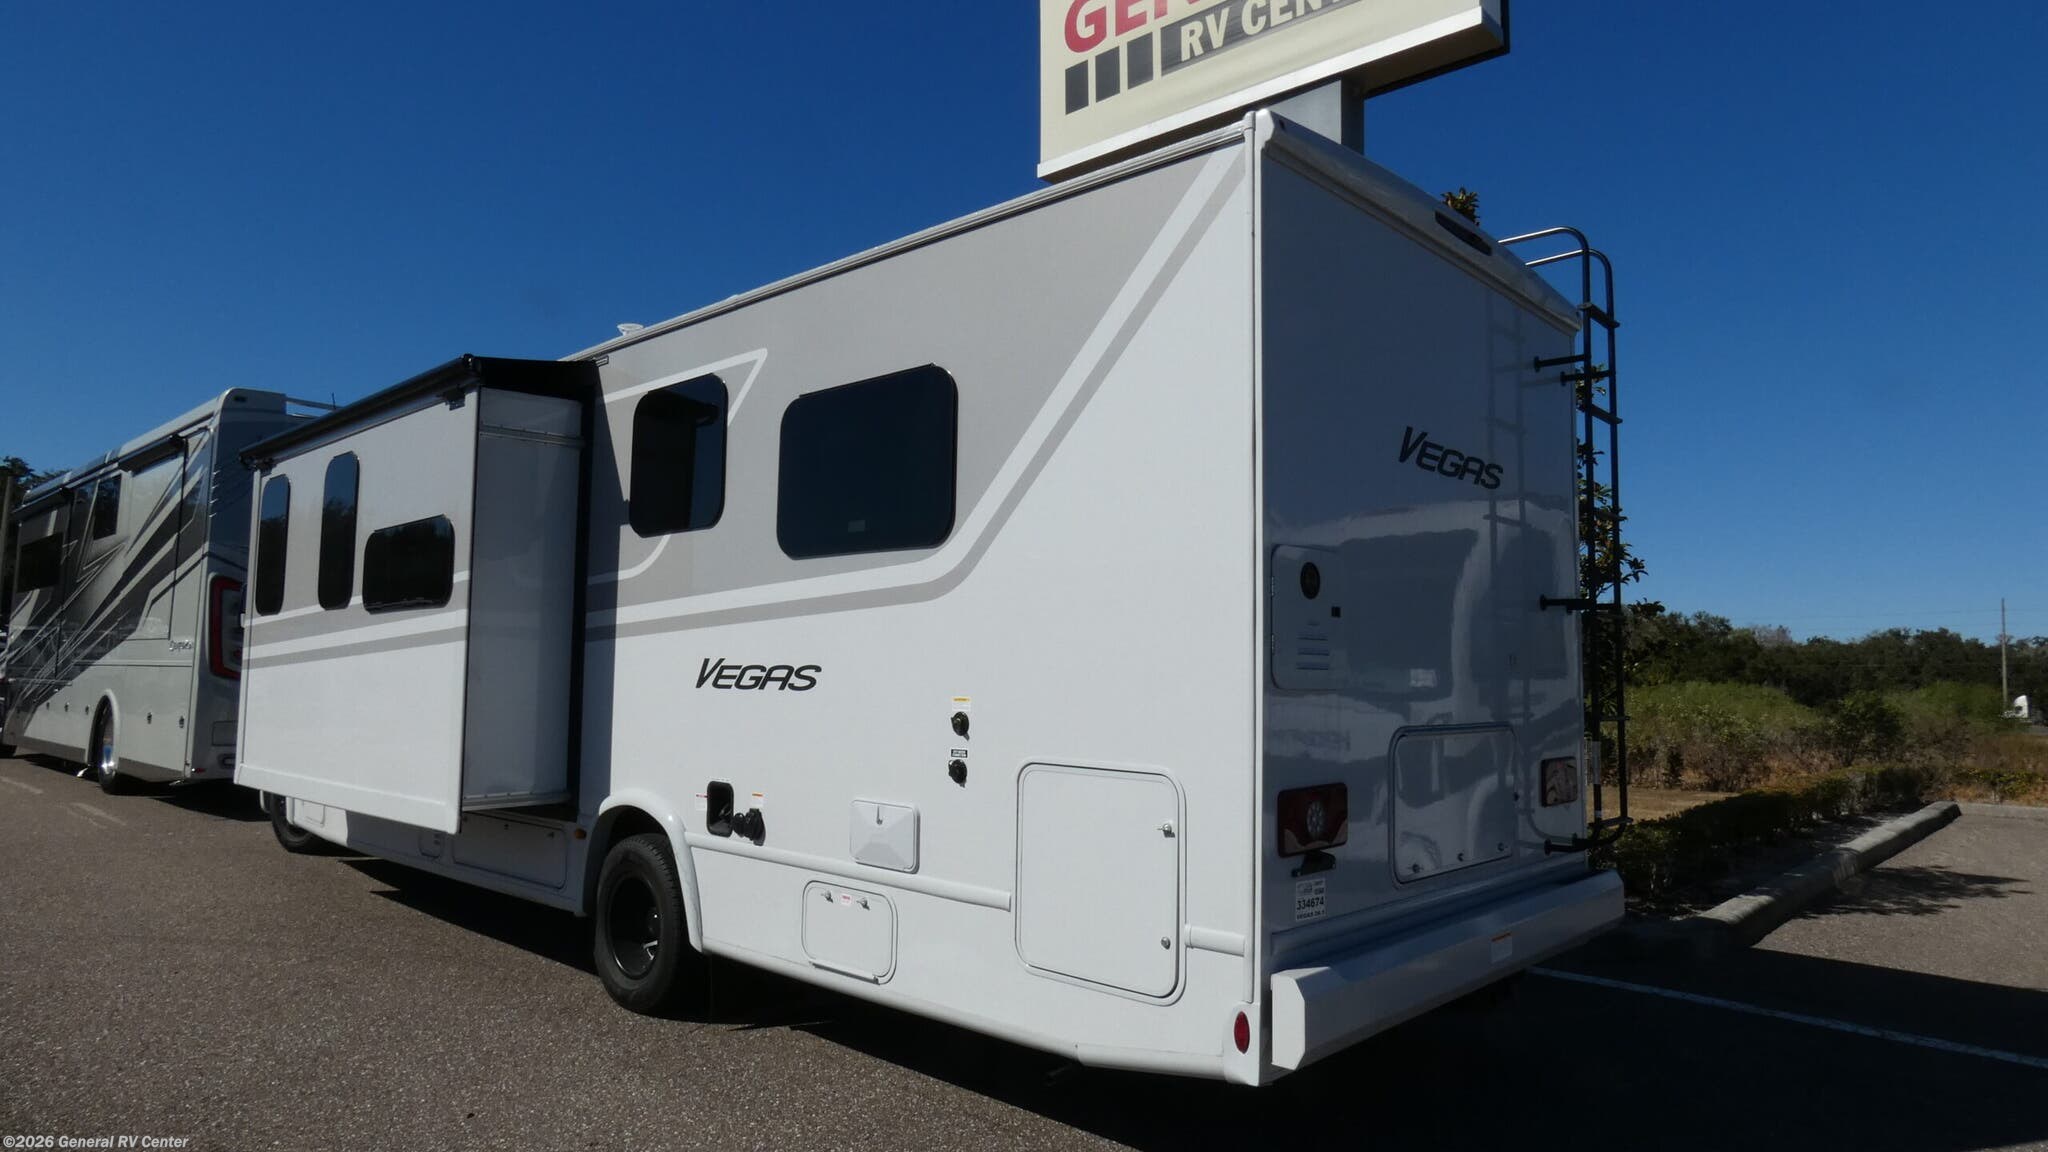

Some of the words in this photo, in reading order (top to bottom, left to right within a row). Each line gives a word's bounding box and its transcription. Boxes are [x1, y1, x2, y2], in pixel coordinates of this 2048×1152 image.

[1180, 6, 1230, 61] RV
[1398, 425, 1504, 489] VEGAS
[695, 657, 823, 691] VEGAS
